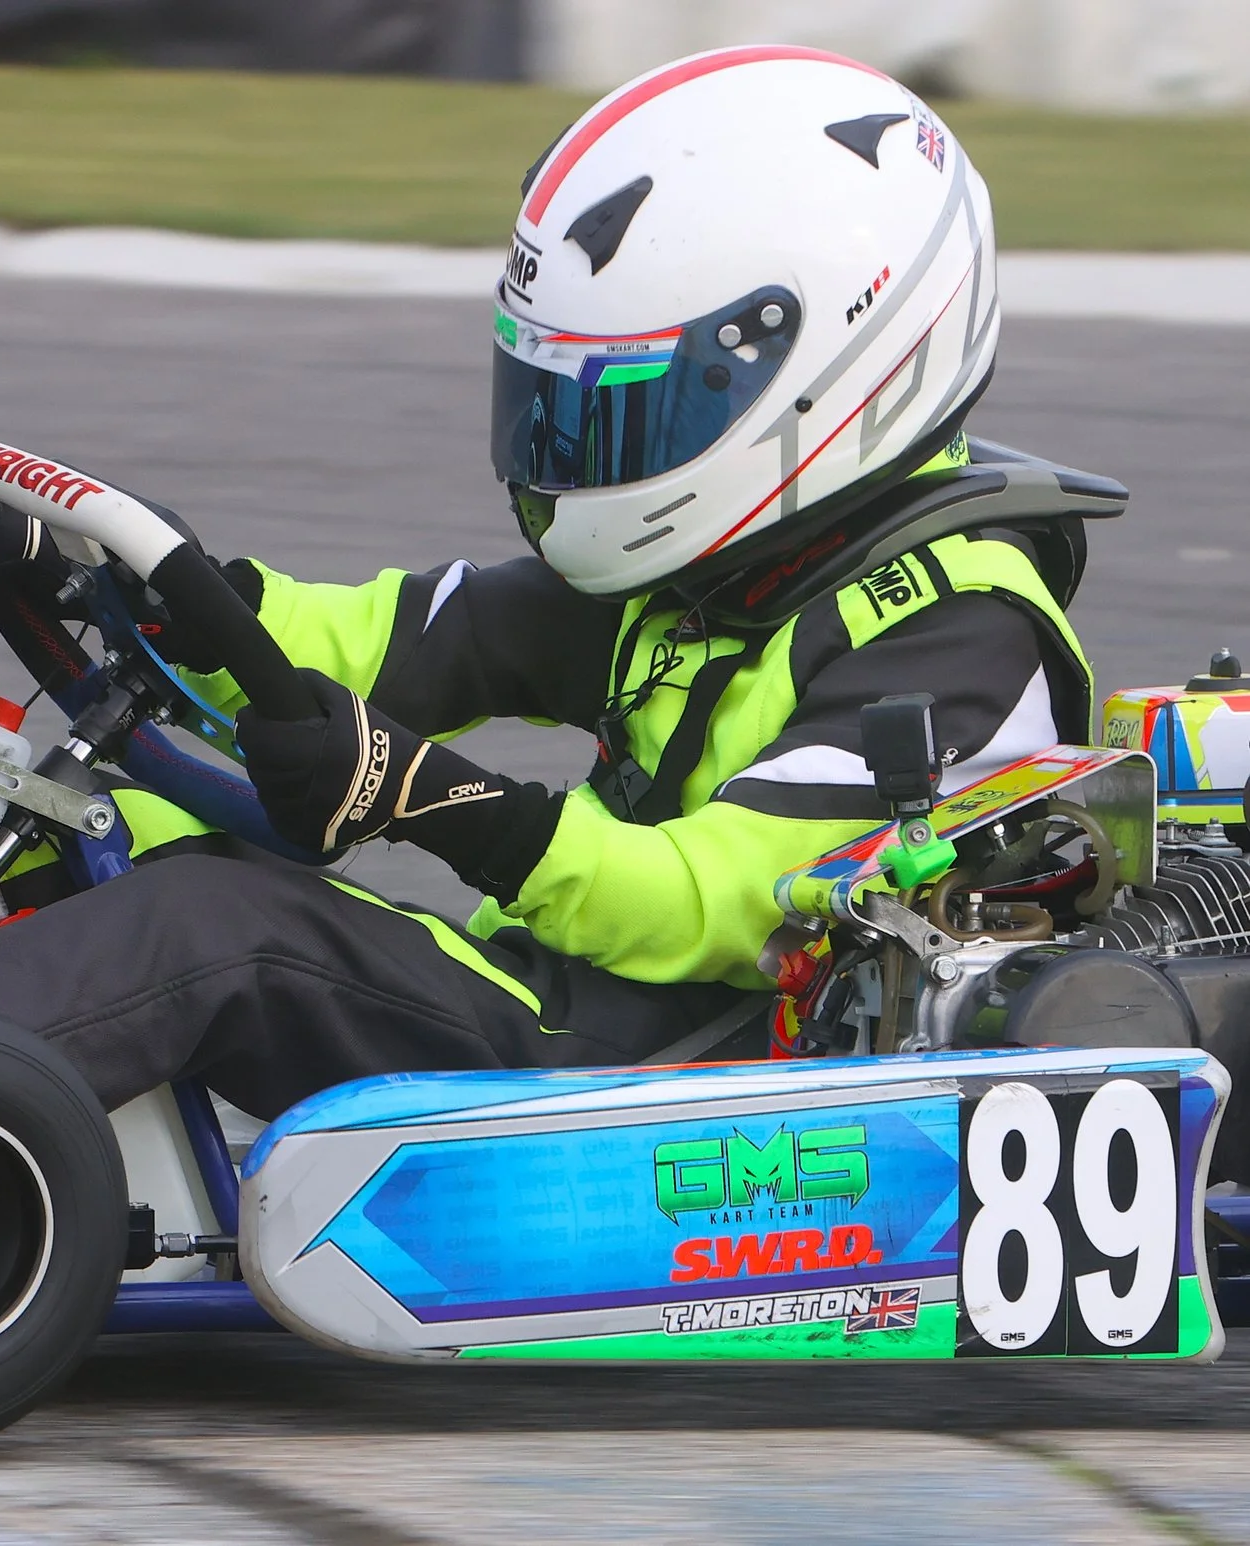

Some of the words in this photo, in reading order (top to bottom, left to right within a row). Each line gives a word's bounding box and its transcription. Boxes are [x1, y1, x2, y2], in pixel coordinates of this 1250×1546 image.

[868, 562, 912, 606] OMP
[449, 781, 486, 799] CRW
[654, 1122, 870, 1227] GMS
[710, 1210, 754, 1225] KART
[768, 1203, 813, 1220] TEAM
[962, 1079, 1177, 1350] 89
[662, 1287, 875, 1334] T.MORETON
[1000, 1332, 1026, 1342] GMS
[1107, 1329, 1133, 1339] GMS
